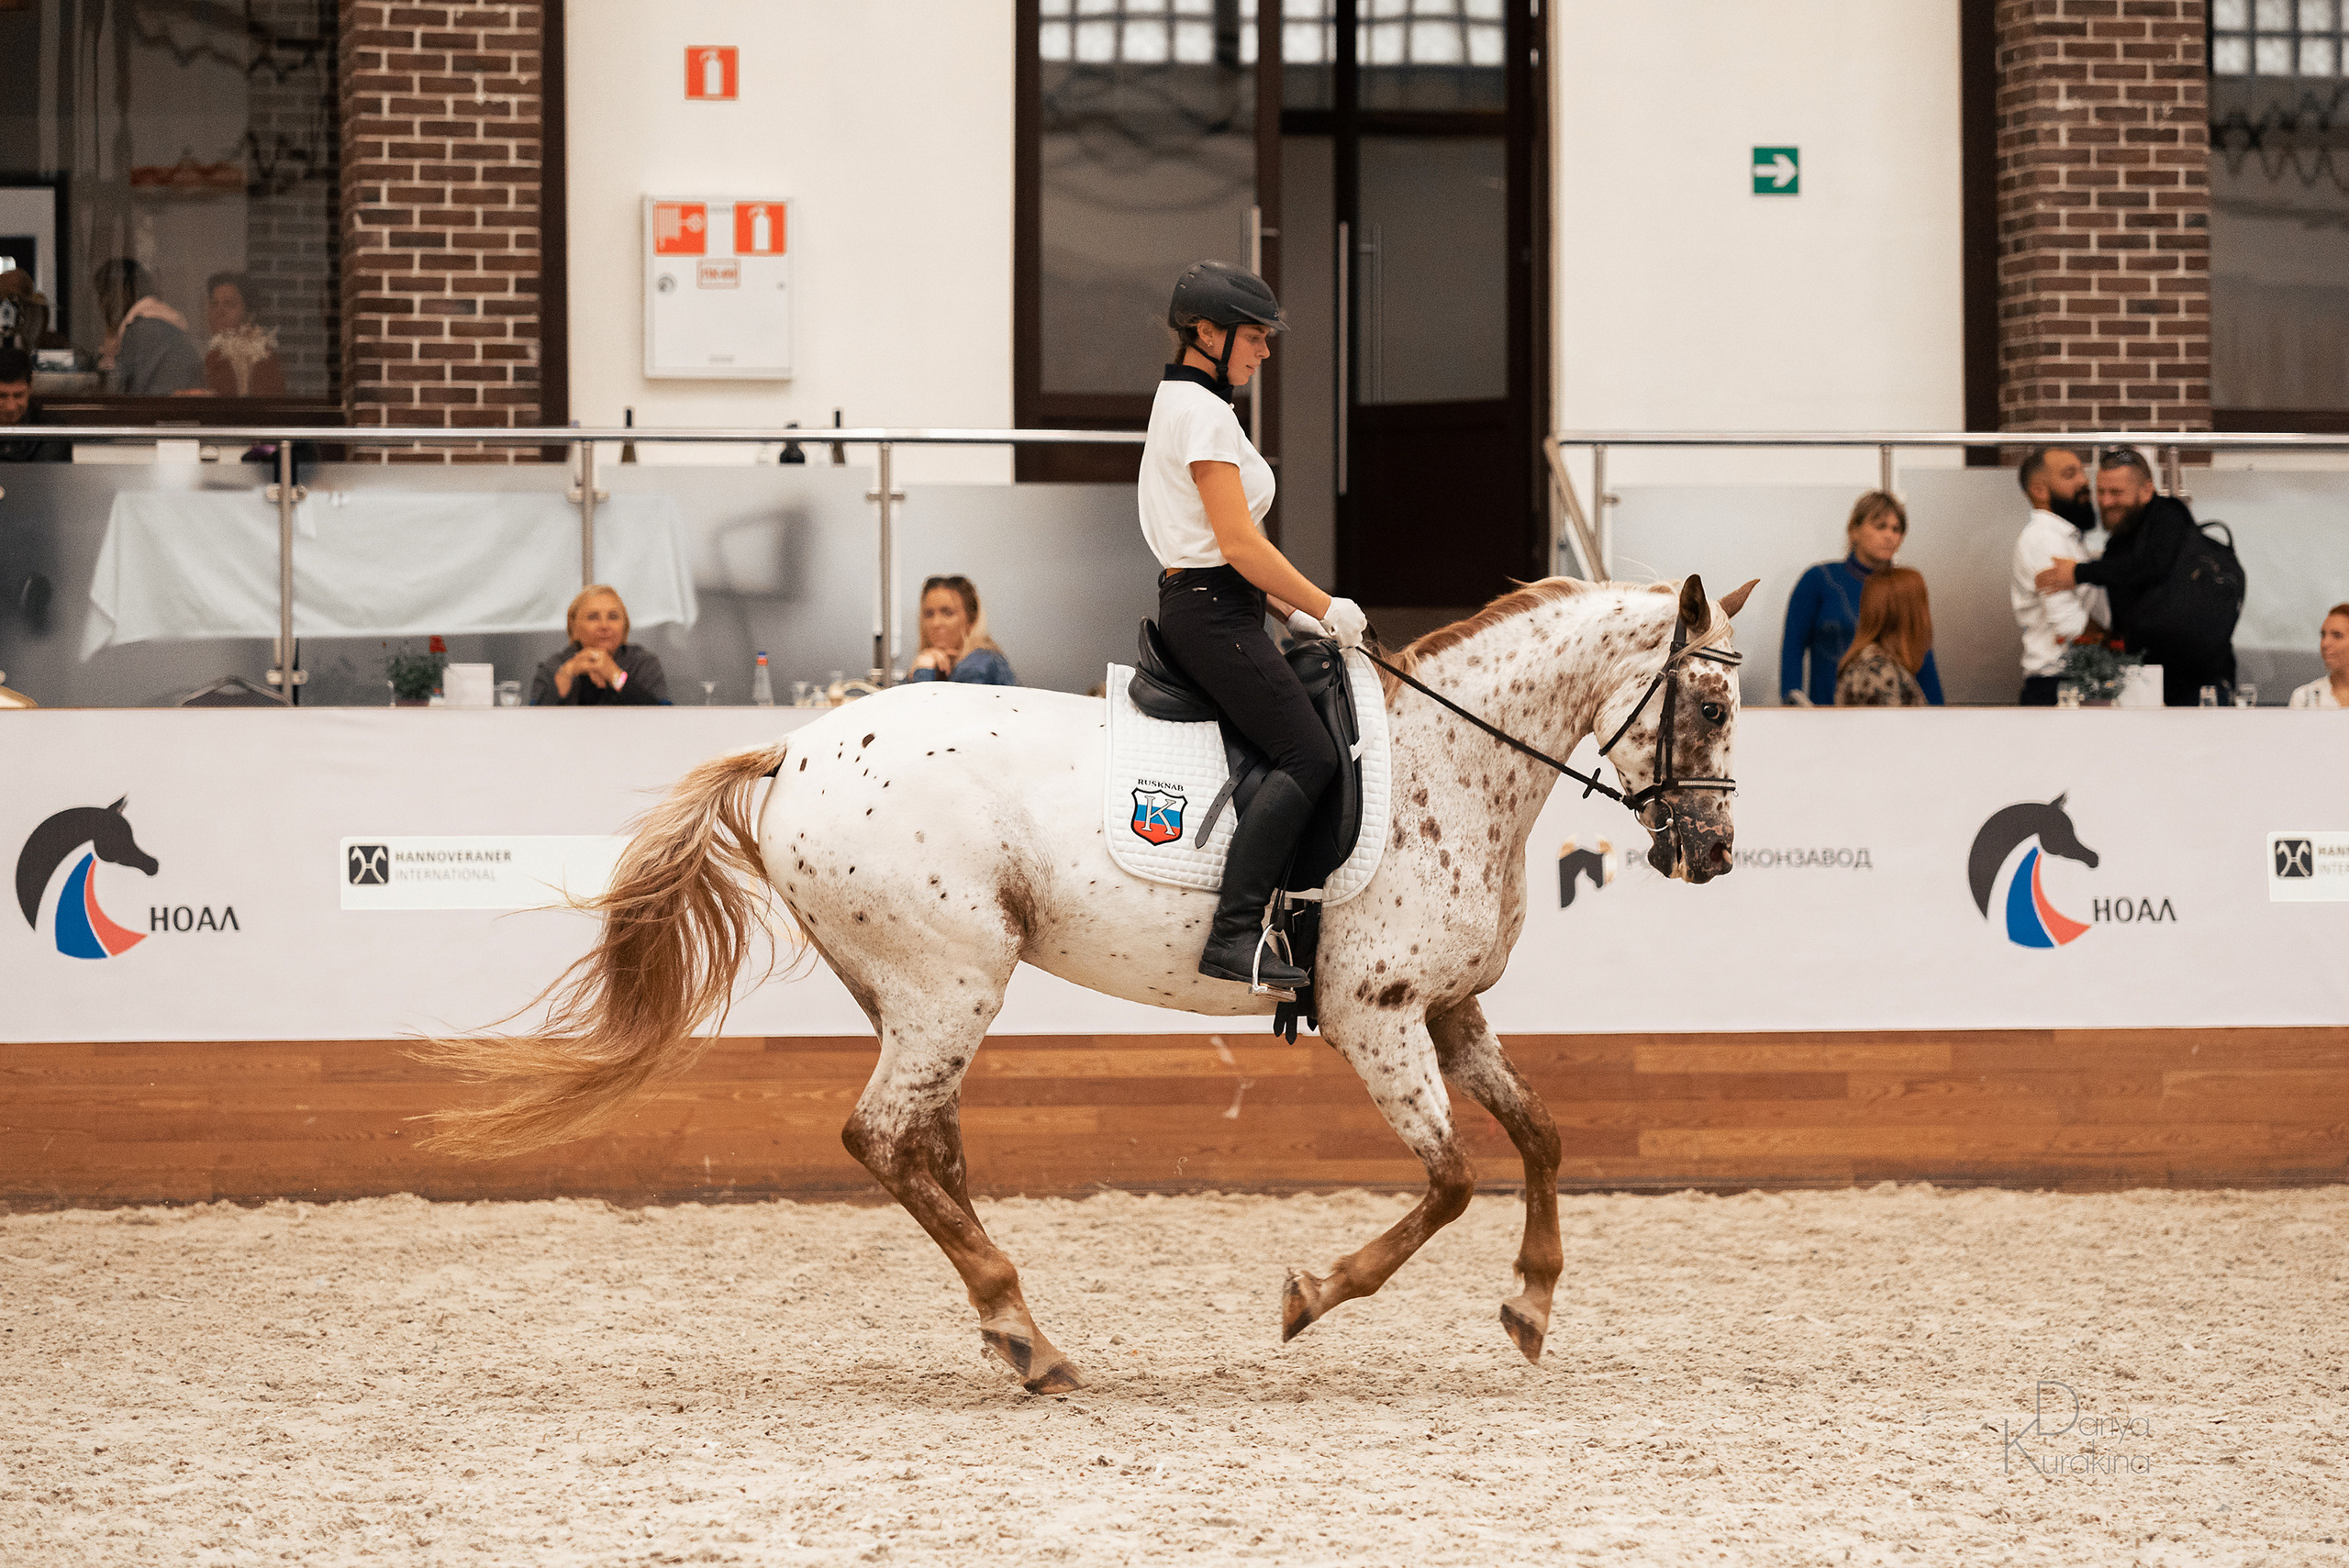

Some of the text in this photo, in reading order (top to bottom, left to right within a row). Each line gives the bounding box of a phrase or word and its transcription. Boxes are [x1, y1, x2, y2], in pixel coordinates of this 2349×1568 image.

[1138, 778, 1184, 791] RUSKNAB
[1141, 795, 1176, 836] K
[395, 850, 512, 862] HANNOVERANER
[395, 868, 496, 882] INTERNATIONAL
